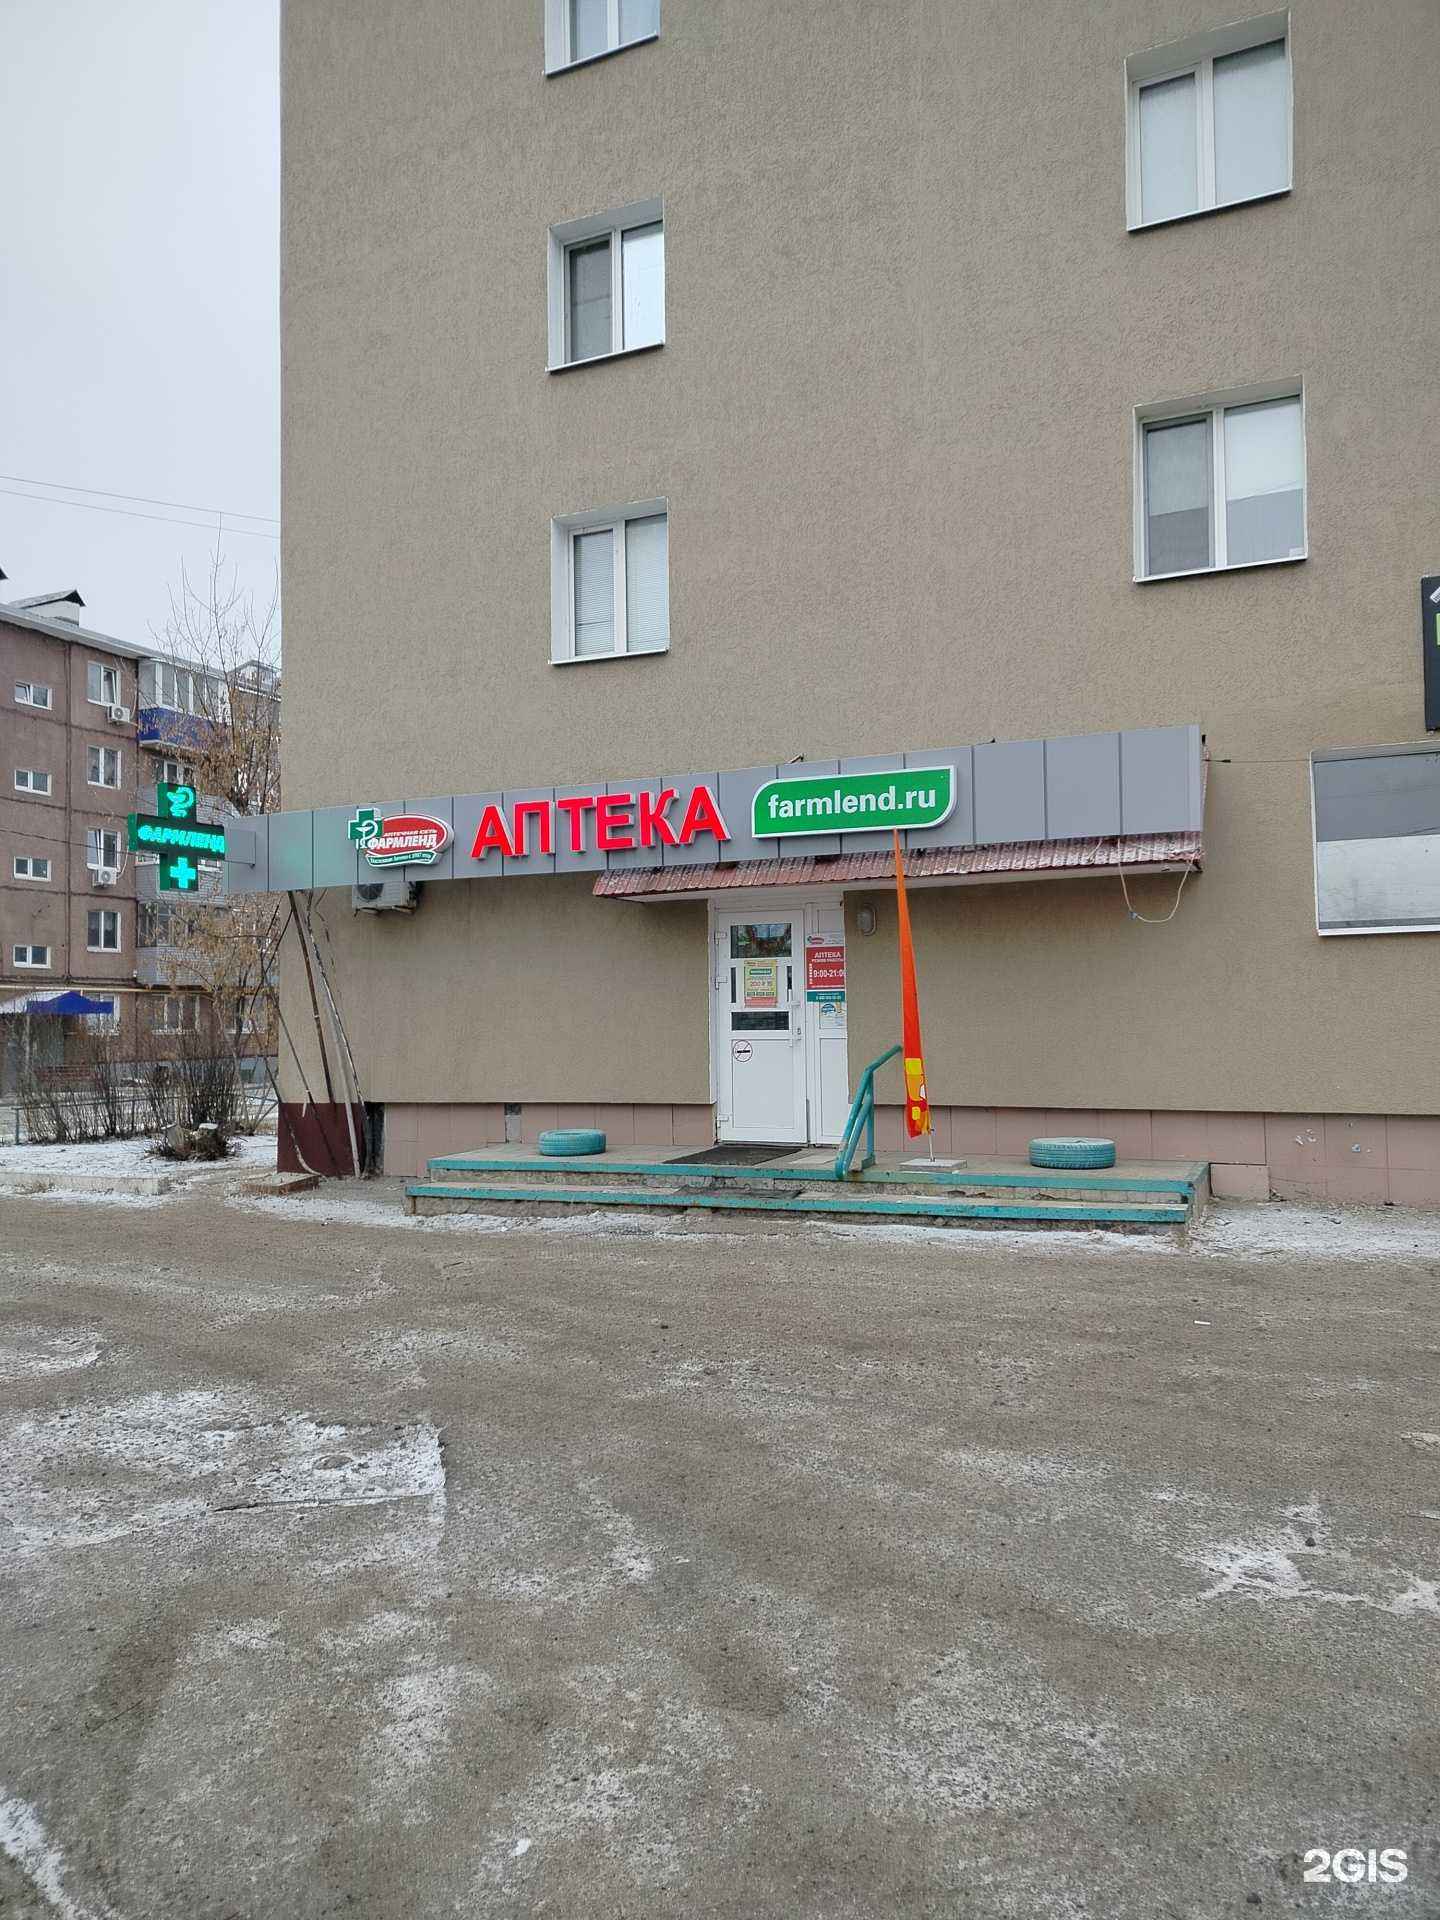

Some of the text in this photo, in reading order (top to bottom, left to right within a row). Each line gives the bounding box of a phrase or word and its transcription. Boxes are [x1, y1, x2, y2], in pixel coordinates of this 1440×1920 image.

[767, 785, 936, 819] farmlend.ru
[471, 785, 731, 858] АПТЕКА
[138, 825, 224, 853] ФАРМЛЕНД
[367, 834, 437, 849] ФАРМЛЕНД
